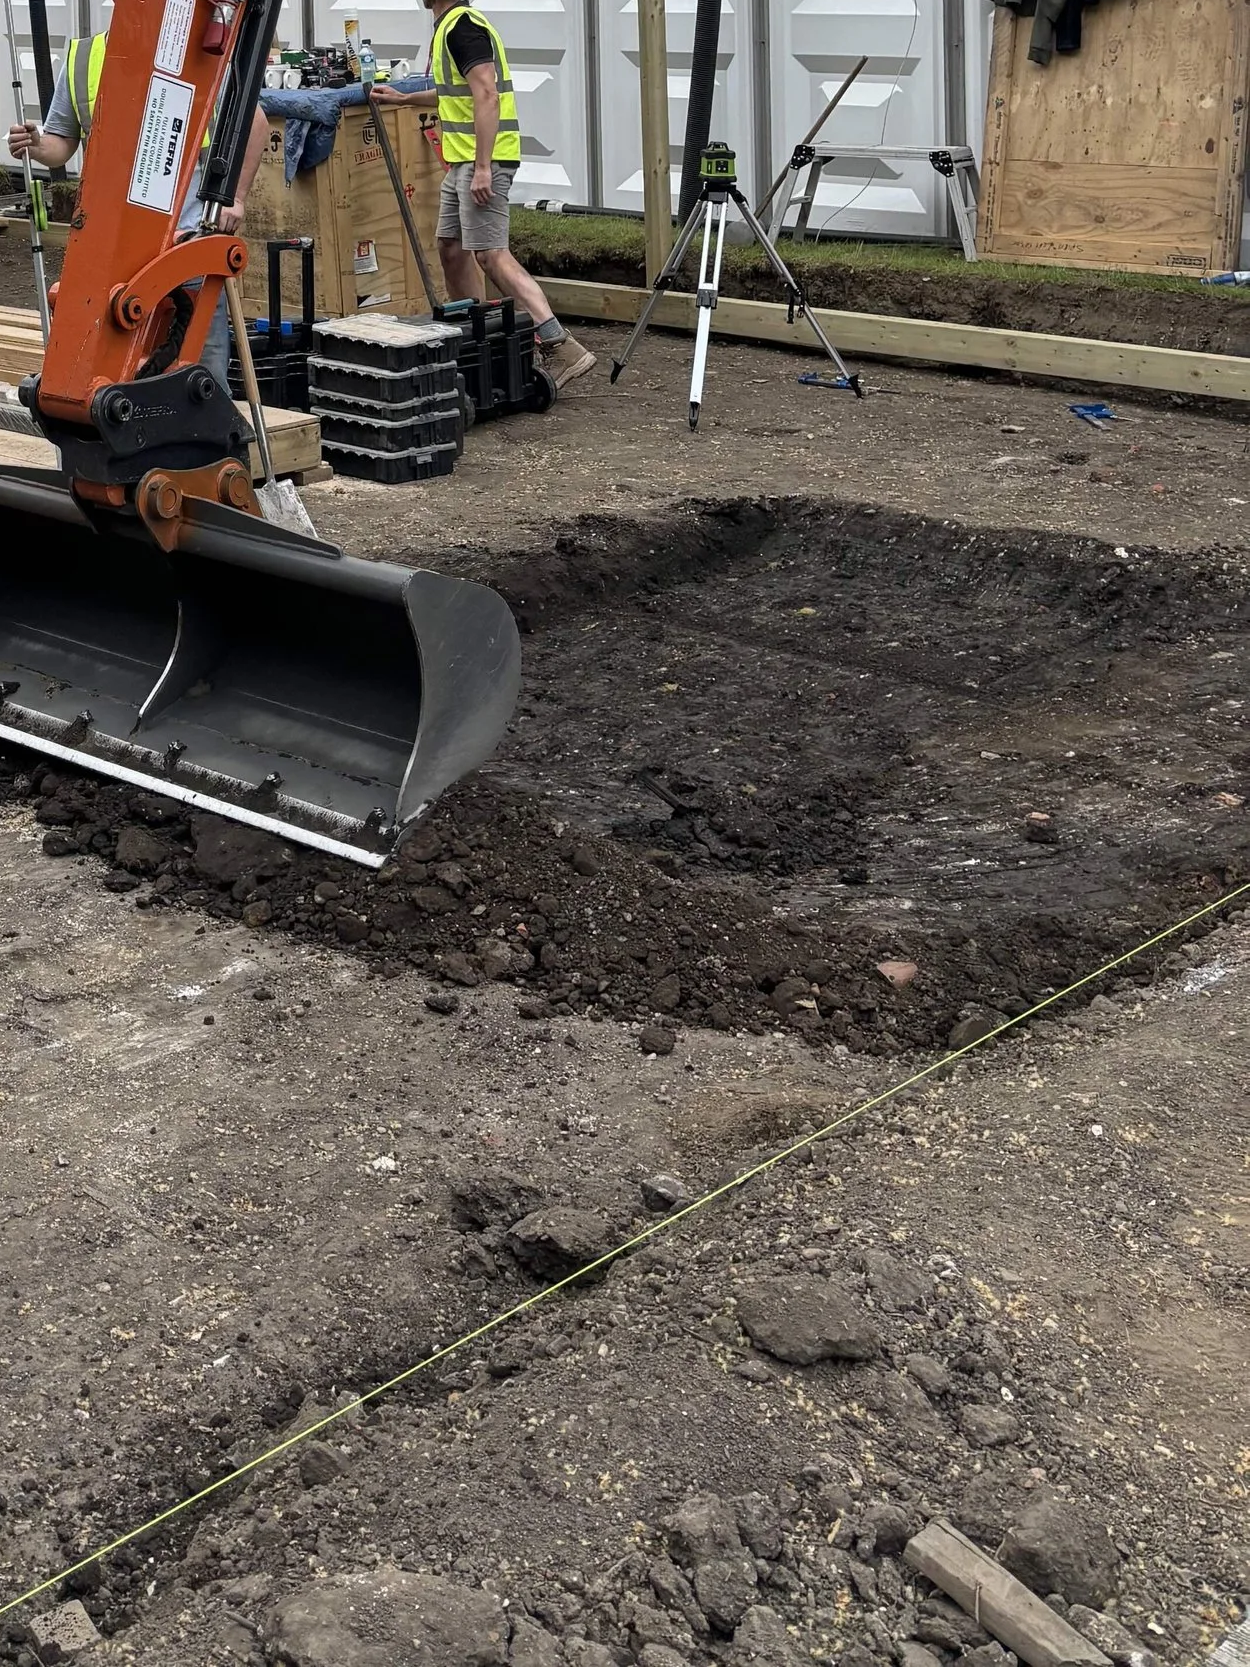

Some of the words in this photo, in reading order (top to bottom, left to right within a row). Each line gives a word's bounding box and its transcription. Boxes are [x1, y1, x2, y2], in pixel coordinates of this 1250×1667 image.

[151, 97, 158, 109] NO
[157, 88, 167, 114] DOUBLE
[147, 110, 156, 132] SAFETY
[152, 114, 161, 145] LOCKING
[160, 116, 169, 136] FULLY
[144, 134, 152, 148] PIN
[153, 135, 165, 173] AUTOMATIC
[137, 148, 148, 184] REQUIRED
[146, 145, 156, 180] COUPLER
[163, 133, 178, 176] TEFRA
[141, 178, 151, 198] FITTED
